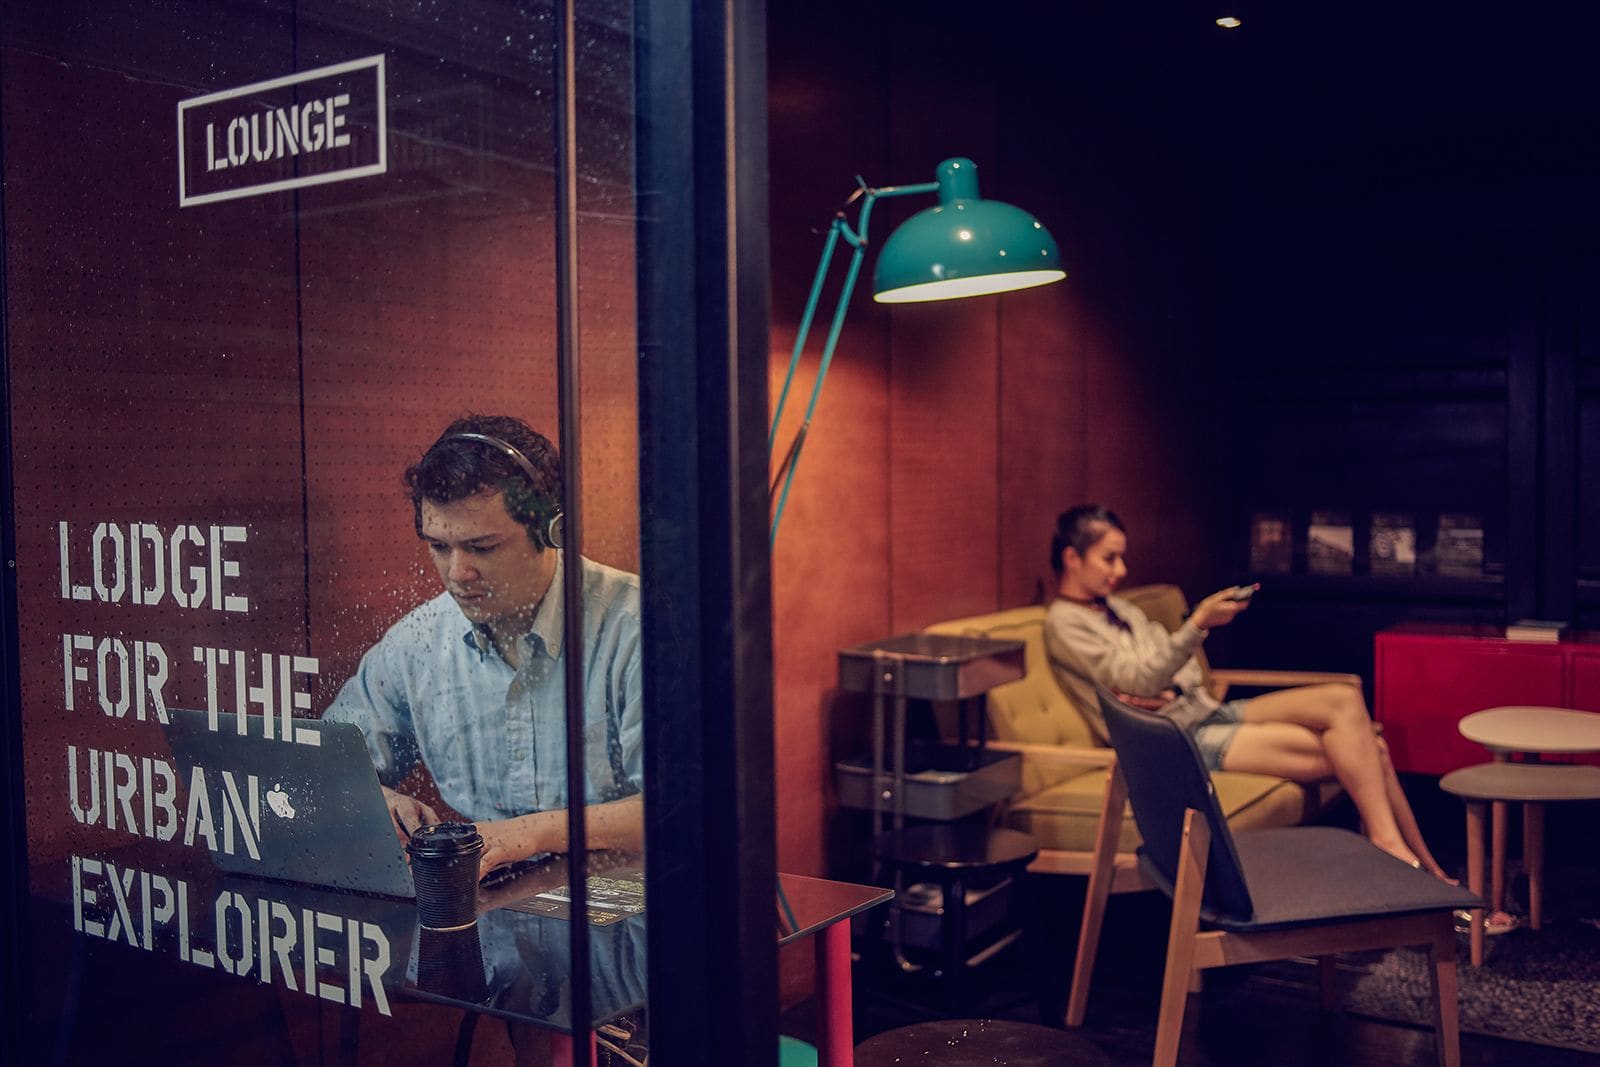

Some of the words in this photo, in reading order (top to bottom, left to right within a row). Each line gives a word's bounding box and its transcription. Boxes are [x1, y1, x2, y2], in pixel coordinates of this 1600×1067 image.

[206, 94, 351, 171] LOUNGE
[60, 521, 249, 612] LODGE
[63, 634, 170, 725] FOR
[194, 646, 321, 746] THE
[67, 745, 261, 860] URBAN
[72, 854, 392, 1017] EXPLORER
